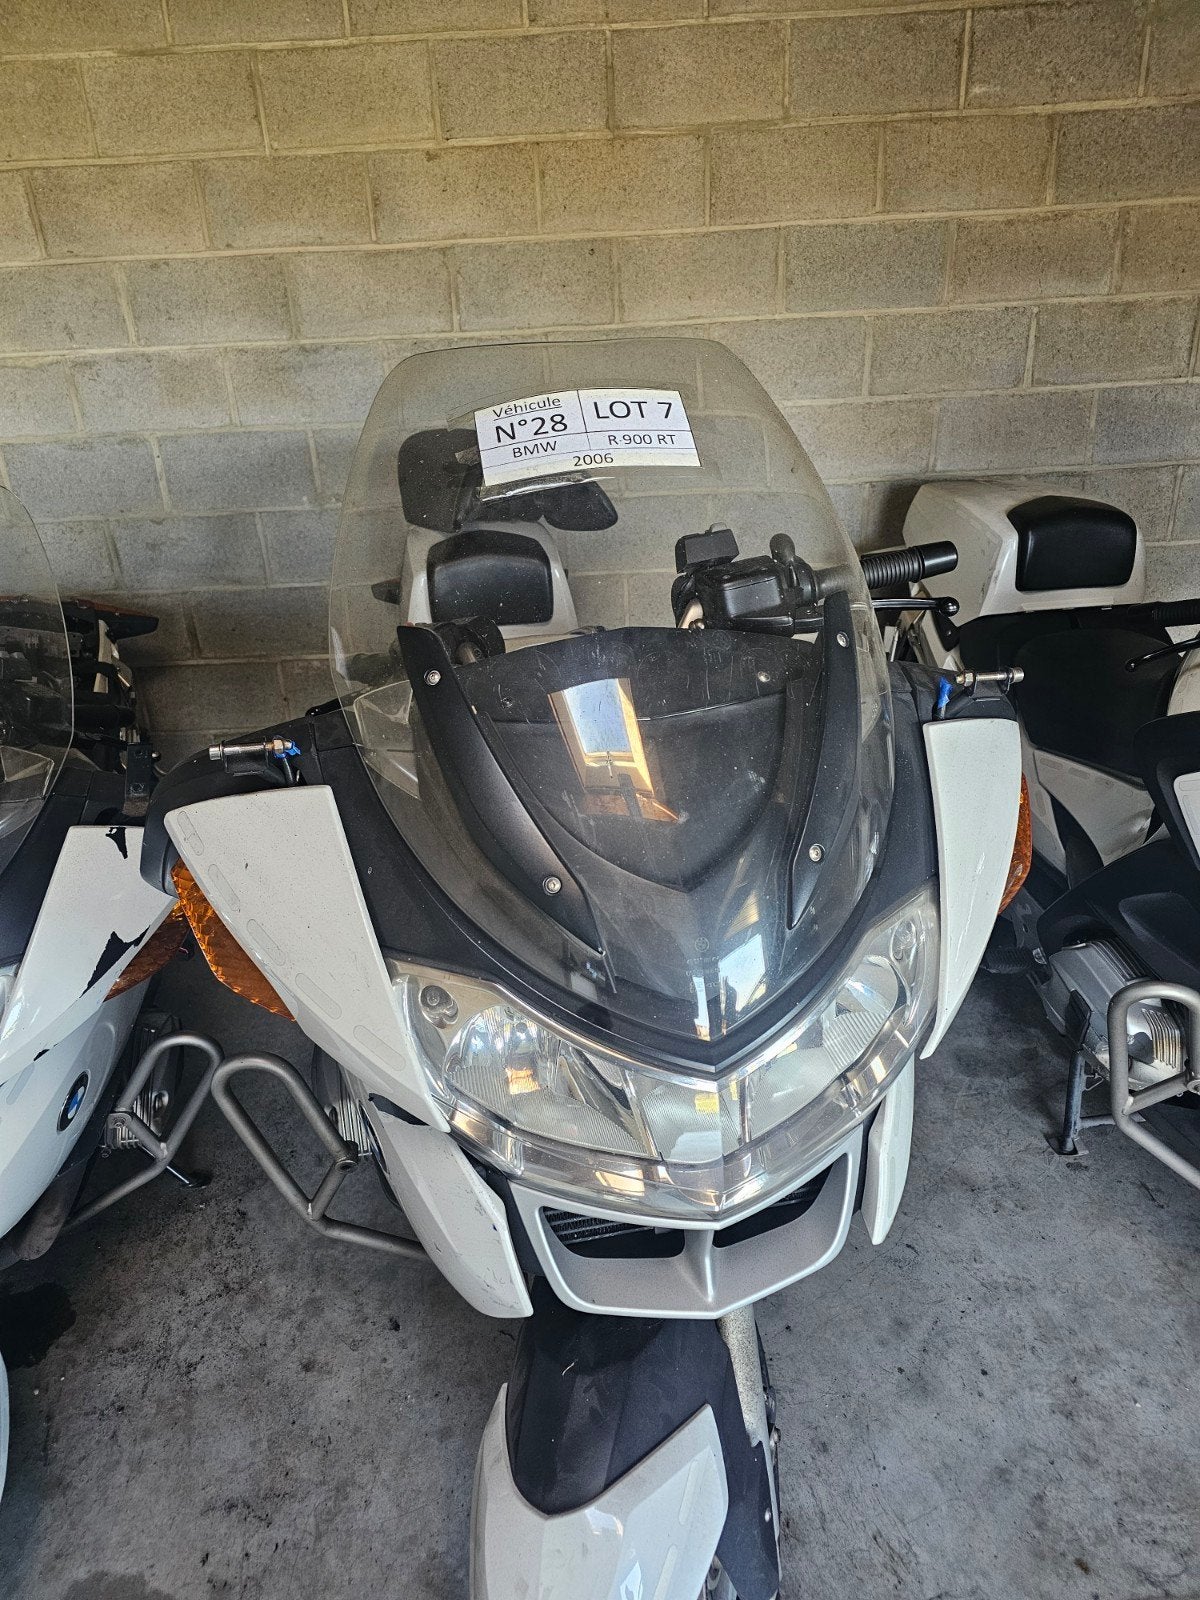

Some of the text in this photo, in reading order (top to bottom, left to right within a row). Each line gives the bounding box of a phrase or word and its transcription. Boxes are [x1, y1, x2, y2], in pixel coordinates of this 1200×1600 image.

[493, 397, 561, 418] Véhicule
[593, 401, 672, 419] LOT 7
[495, 413, 568, 443] N°28
[657, 434, 676, 444] RT
[513, 441, 557, 458] BMW
[573, 453, 614, 467] 2006
